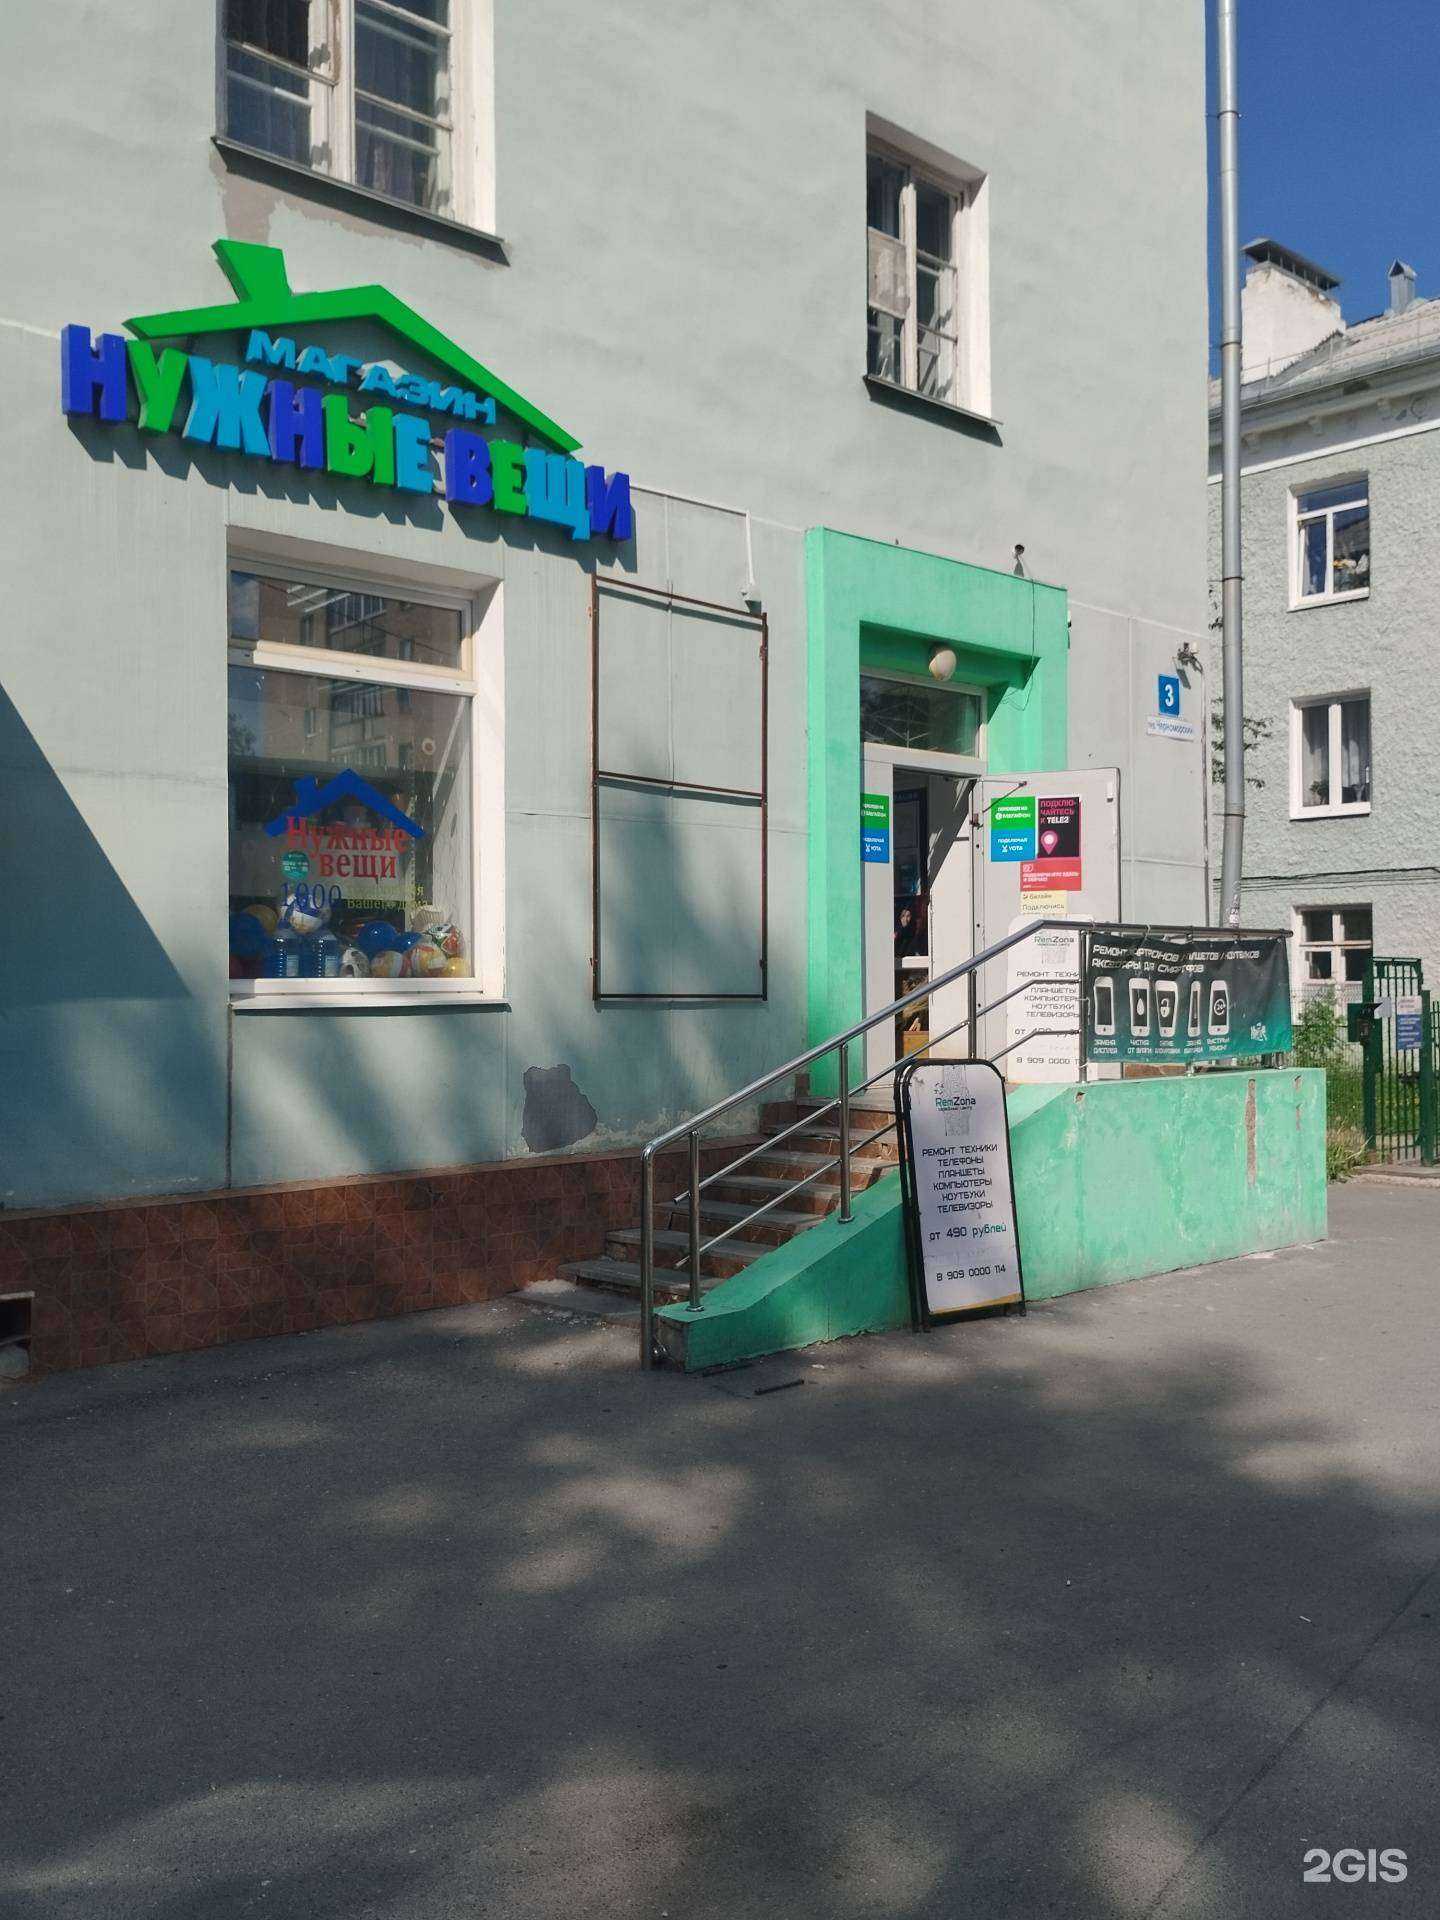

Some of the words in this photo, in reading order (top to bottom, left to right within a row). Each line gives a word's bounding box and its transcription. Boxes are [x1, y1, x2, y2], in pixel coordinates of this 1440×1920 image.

[246, 329, 497, 424] МАГАЗИН
[60, 323, 434, 495] НУЖНЫЕ
[443, 427, 634, 541] ВЕЩИ
[1165, 684, 1174, 707] 3
[1047, 816, 1069, 824] TELE2
[286, 816, 409, 860] Нужные
[319, 853, 398, 884] вещи
[1093, 944, 1127, 957] РЕМОНТ
[921, 1146, 956, 1157] РЕМОНТ
[958, 1143, 998, 1154] ТЕХНИКИ
[936, 1156, 984, 1167] ТЕЛЕФОНЫ
[938, 1166, 985, 1179] ПЛАНШЕТЫ
[932, 1177, 993, 1191] КОМПЬЮТЕРЫ
[942, 1189, 986, 1202] НОУТБУКИ
[936, 1201, 994, 1214] ТЕЛЕВИЗОРЫ
[929, 1231, 941, 1241] от
[946, 1226, 967, 1238] 490
[972, 1221, 1007, 1238] рублей
[936, 1272, 943, 1281] 8
[946, 1268, 965, 1280] 909
[968, 1266, 991, 1277] 0000
[994, 1264, 1006, 1274] 114
